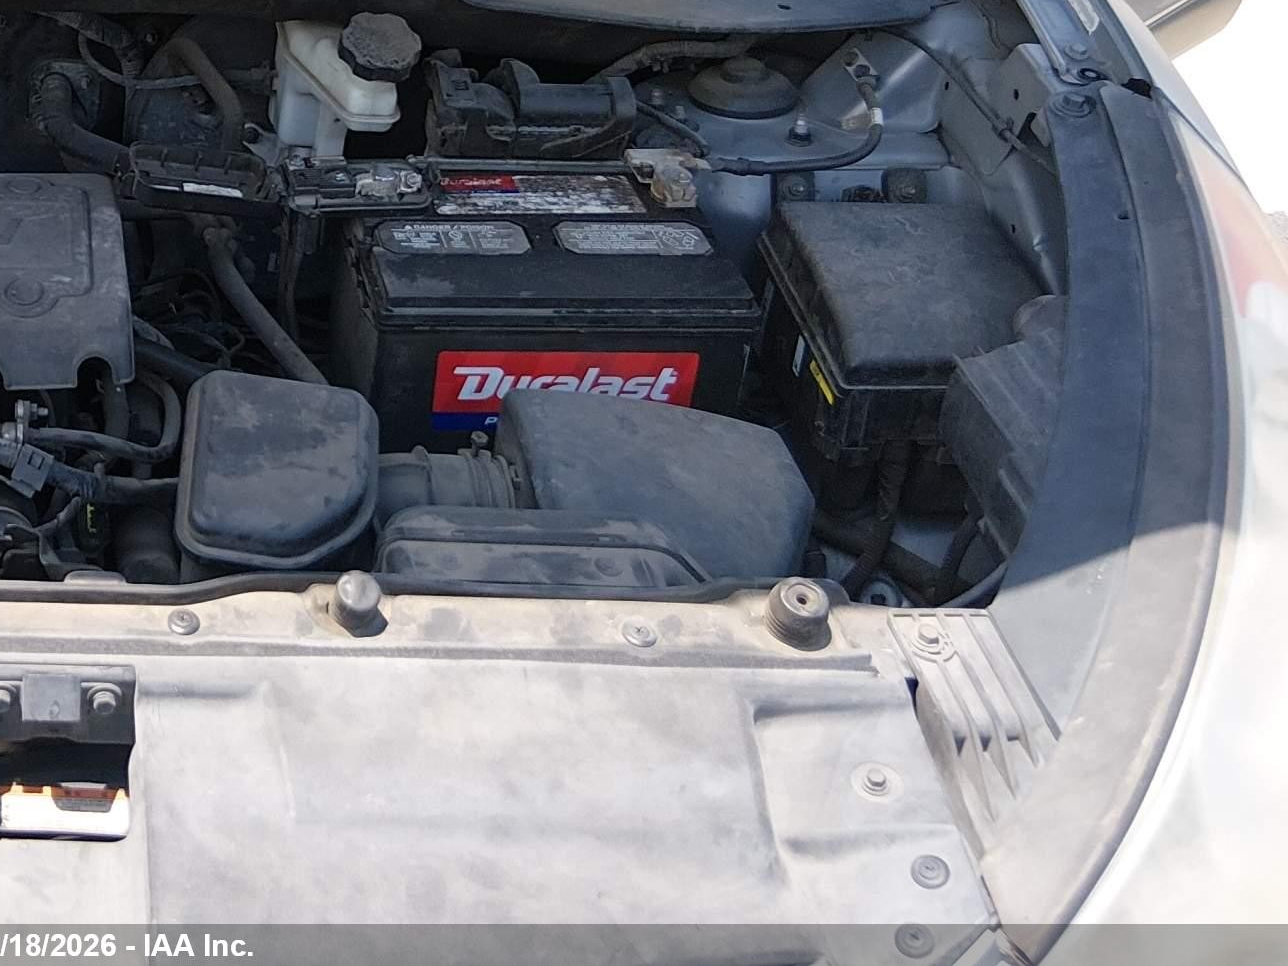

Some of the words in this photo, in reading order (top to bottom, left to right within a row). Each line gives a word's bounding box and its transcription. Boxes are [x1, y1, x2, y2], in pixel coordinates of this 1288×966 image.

[440, 177, 502, 186] Duralast
[413, 224, 451, 232] DANGER
[453, 366, 679, 401] Duralast
